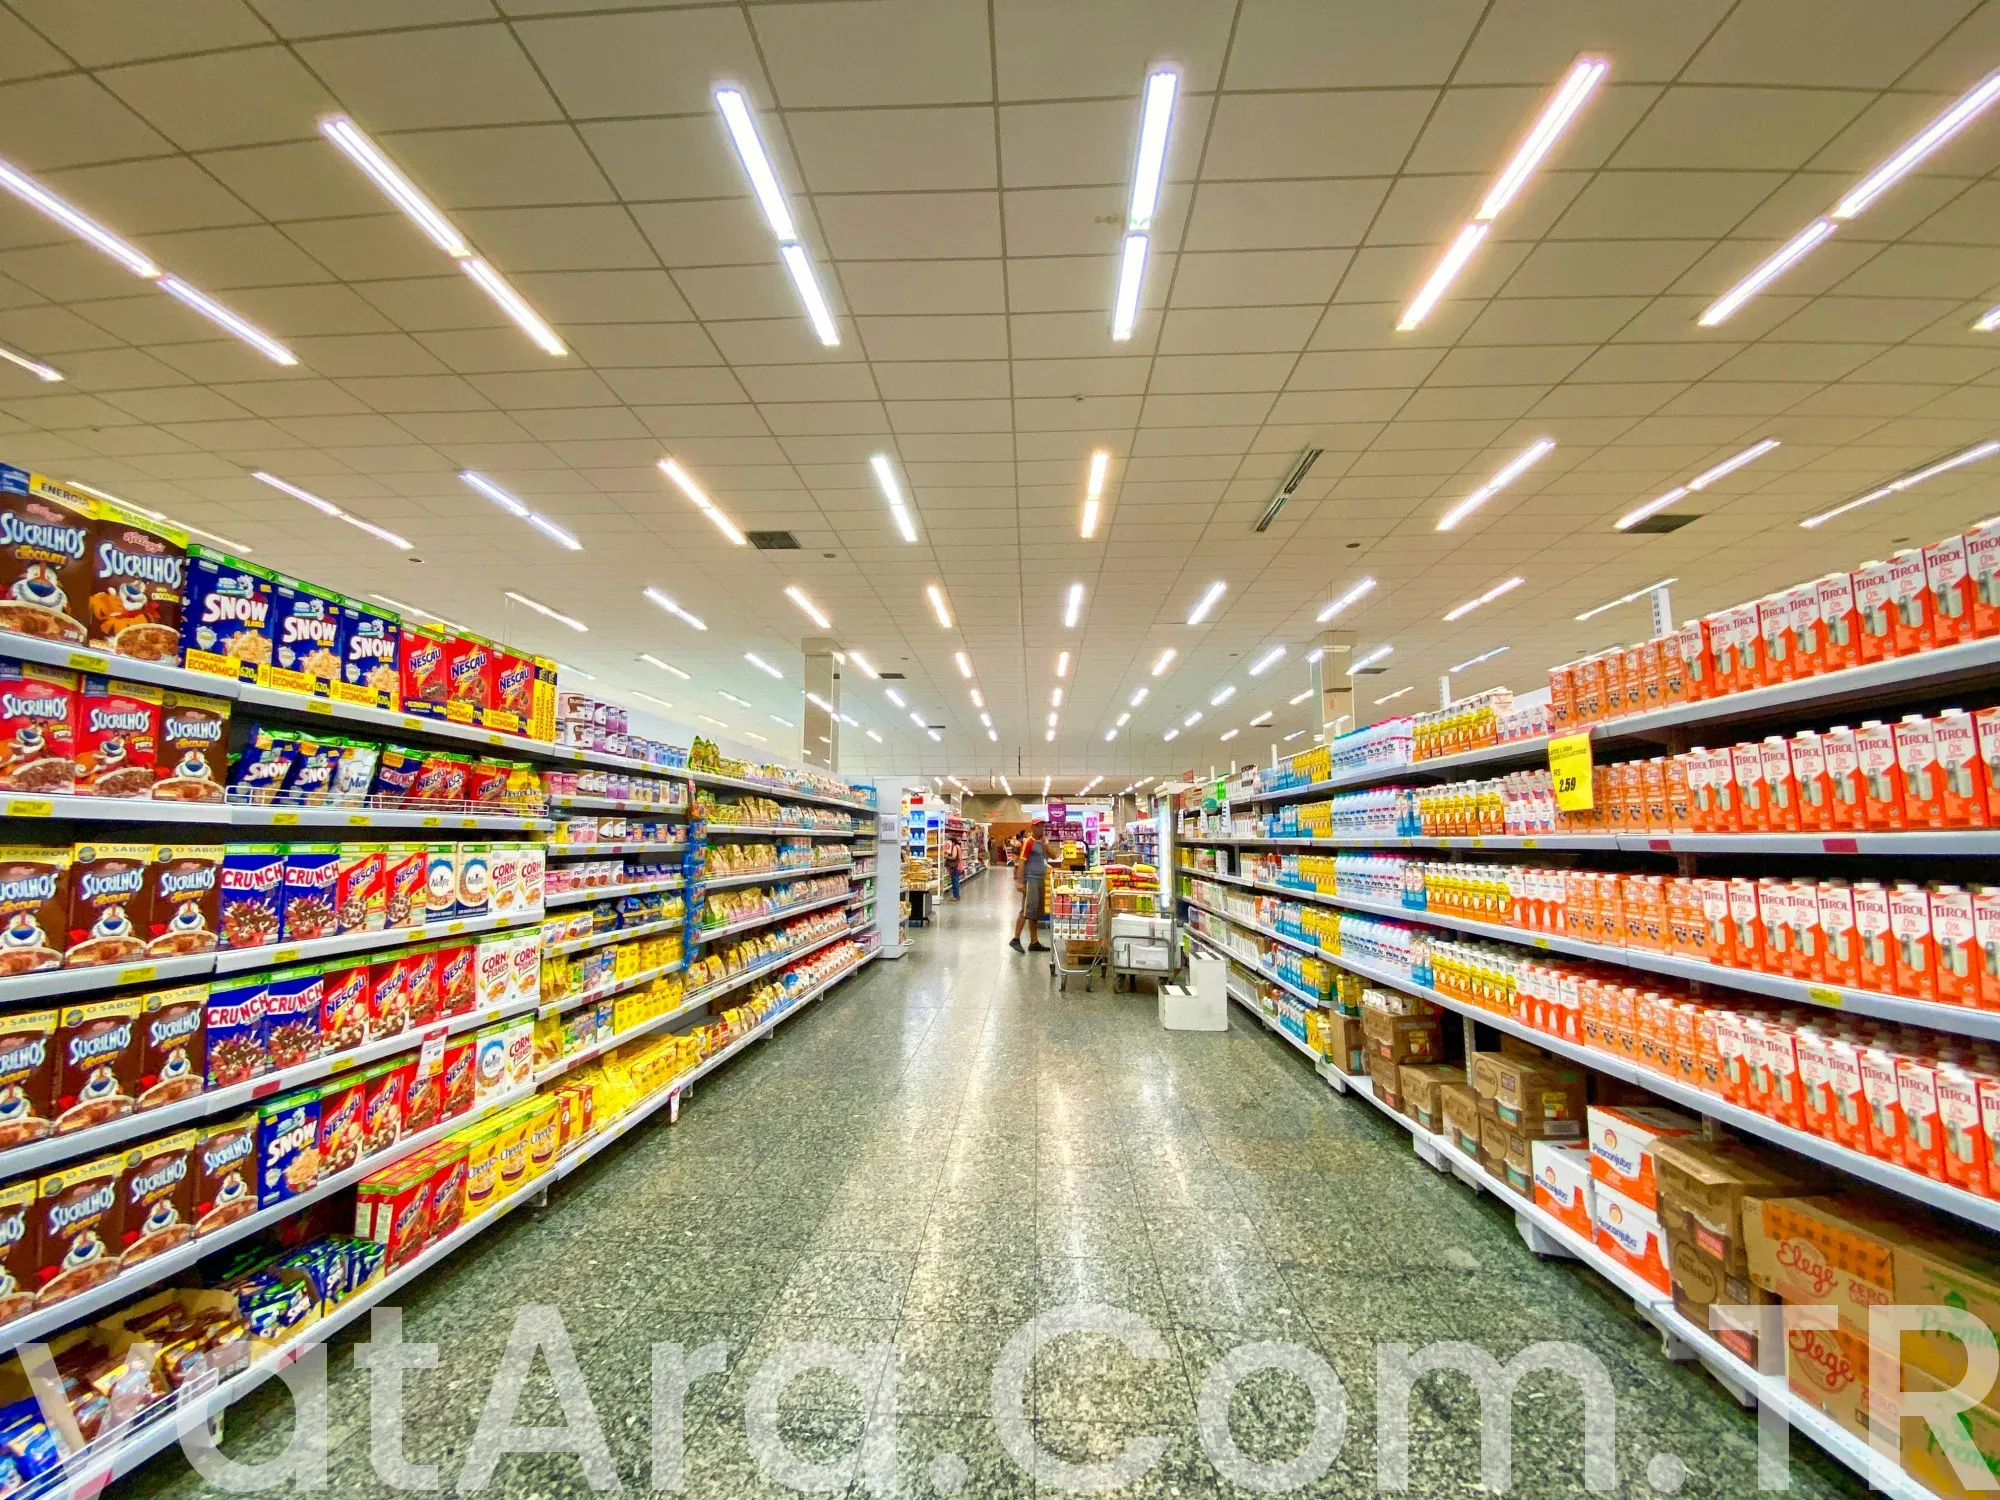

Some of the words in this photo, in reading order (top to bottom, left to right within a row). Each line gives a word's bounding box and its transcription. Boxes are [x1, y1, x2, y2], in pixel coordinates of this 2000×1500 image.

[0, 512, 87, 560] SUCRILHOS
[99, 542, 183, 589] SUCRILHOS
[1926, 548, 1964, 569] TIROL
[1856, 574, 1888, 592] TIROL
[1889, 562, 1923, 581] TIROL
[1789, 595, 1817, 612] TIROL
[1820, 586, 1851, 603] TIROL
[202, 593, 269, 623] SNOW
[1761, 604, 1788, 620] TIROL
[283, 615, 337, 644] SNOW
[1733, 615, 1756, 630] TIROL
[349, 635, 395, 661] SNOW
[187, 660, 238, 678] ECONÔMICA
[408, 648, 441, 673] NESCAU
[450, 655, 486, 680] NESCAU
[498, 666, 530, 693] NESCAU
[2, 693, 68, 720] SUCRILHOS
[90, 708, 150, 733] SUCRILHOS
[165, 719, 222, 743] SUCRILHOS
[1857, 738, 1892, 752] TIROL
[1896, 732, 1933, 748] TIROL
[1935, 727, 1972, 743] TIROL
[1734, 754, 1759, 766] TIROL
[1763, 751, 1788, 762] TIROL
[1793, 747, 1822, 759] TIROL
[1825, 743, 1855, 756] TIROL
[244, 762, 291, 781] SNOW
[1559, 776, 1576, 793] 2,59
[112, 846, 153, 857] SABOR
[187, 847, 224, 858] SABOR
[222, 864, 283, 888] CRUNCH
[285, 863, 339, 887] CRUNCH
[348, 859, 381, 891] NESCAU
[394, 859, 424, 889] NESCAU
[492, 862, 516, 880] CORN
[521, 861, 543, 878] CORN
[0, 873, 58, 901] UCRILHOS
[82, 867, 144, 901] SUCRILHOS
[161, 867, 215, 898] SUCRILHOS
[1730, 892, 1753, 903] TIROL
[1786, 896, 1815, 909] TIROL
[1819, 898, 1849, 911] TIROL
[1856, 900, 1886, 914] TIROL
[1891, 902, 1926, 917] TIROL
[1932, 904, 1970, 920] TIROL
[443, 949, 472, 984] NESCAU
[482, 951, 507, 974] CORN
[514, 946, 537, 969] CORN
[266, 983, 323, 1013] CRUNCH
[325, 974, 366, 1018] NESCAU
[374, 967, 408, 1006] NESCAU
[208, 993, 268, 1025] CRUNCH
[151, 1007, 201, 1048] SUCRILHOS
[70, 1022, 132, 1065] SUCRILHOS
[509, 1035, 530, 1058] CORN
[1798, 1049, 1826, 1066] TIROL
[1827, 1057, 1856, 1075] TIROL
[1861, 1066, 1895, 1084] TIROL
[1899, 1075, 1933, 1096] TIROL
[366, 1077, 399, 1122] NESCAU
[1937, 1085, 1974, 1106] TIROL
[322, 1093, 361, 1142] NESCAU
[267, 1120, 318, 1167] SNOW
[132, 1154, 187, 1204] SUCRILHOS
[50, 1182, 116, 1236] SUCRILHOS
